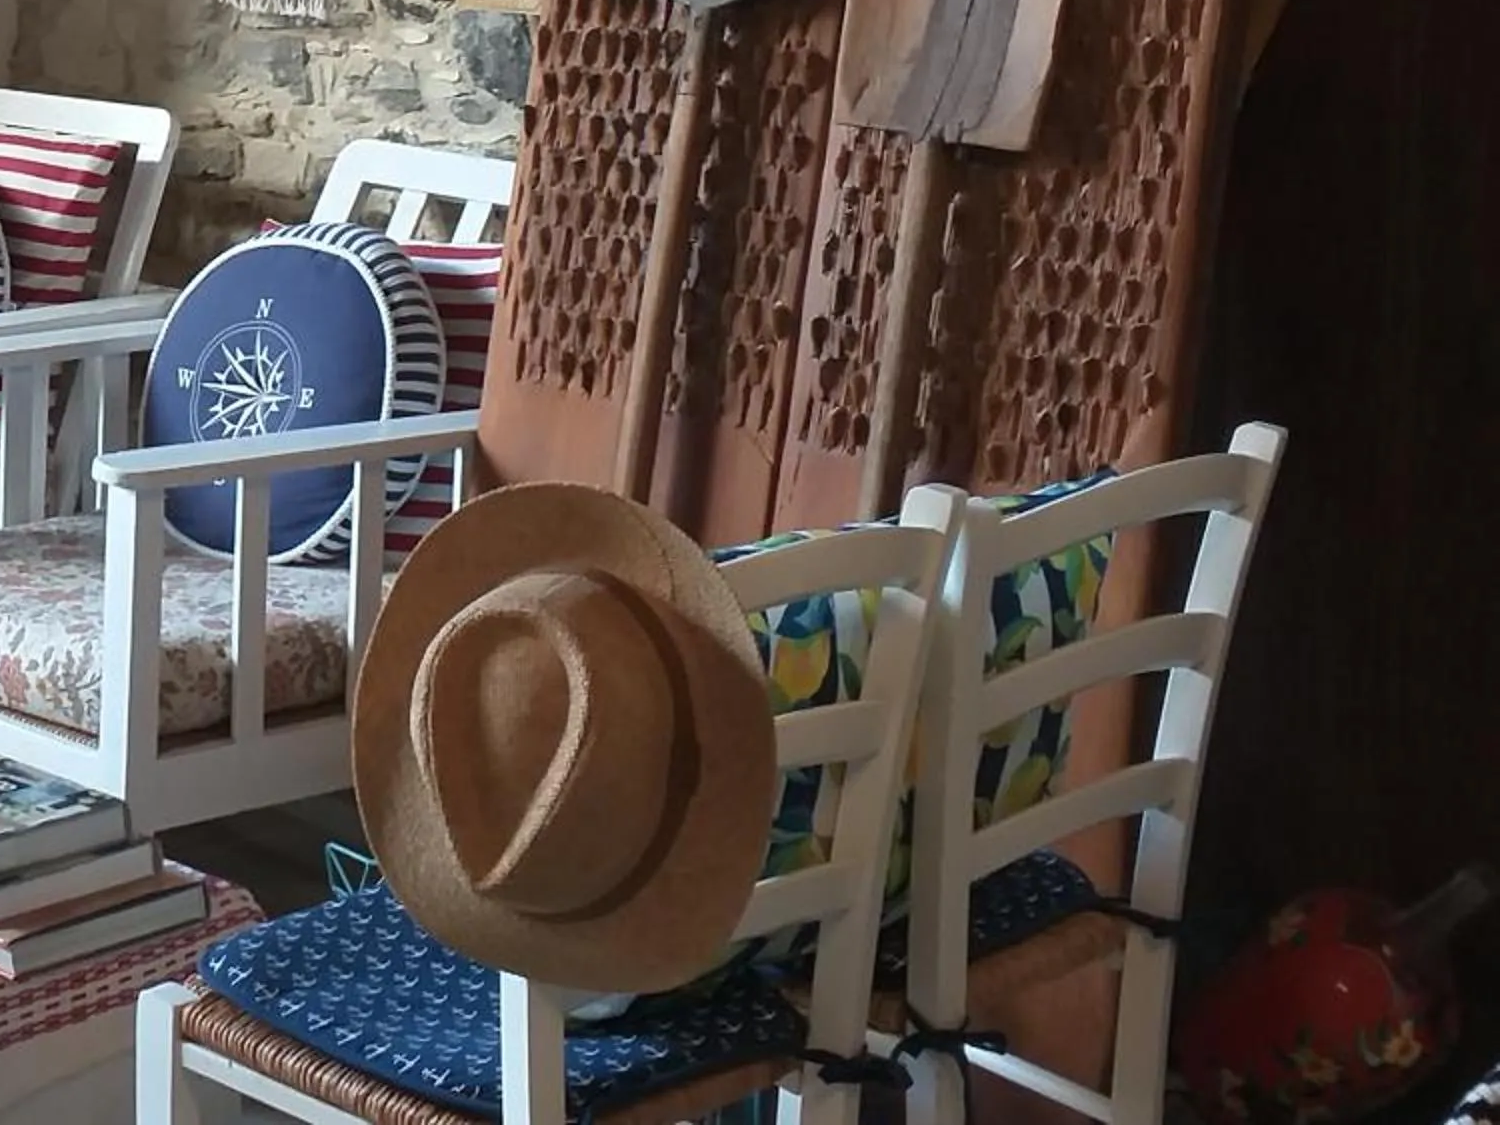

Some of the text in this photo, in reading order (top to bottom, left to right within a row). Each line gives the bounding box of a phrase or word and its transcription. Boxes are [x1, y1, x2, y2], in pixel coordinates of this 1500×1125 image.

[256, 298, 273, 319] N
[177, 367, 196, 388] W
[299, 388, 315, 409] E
